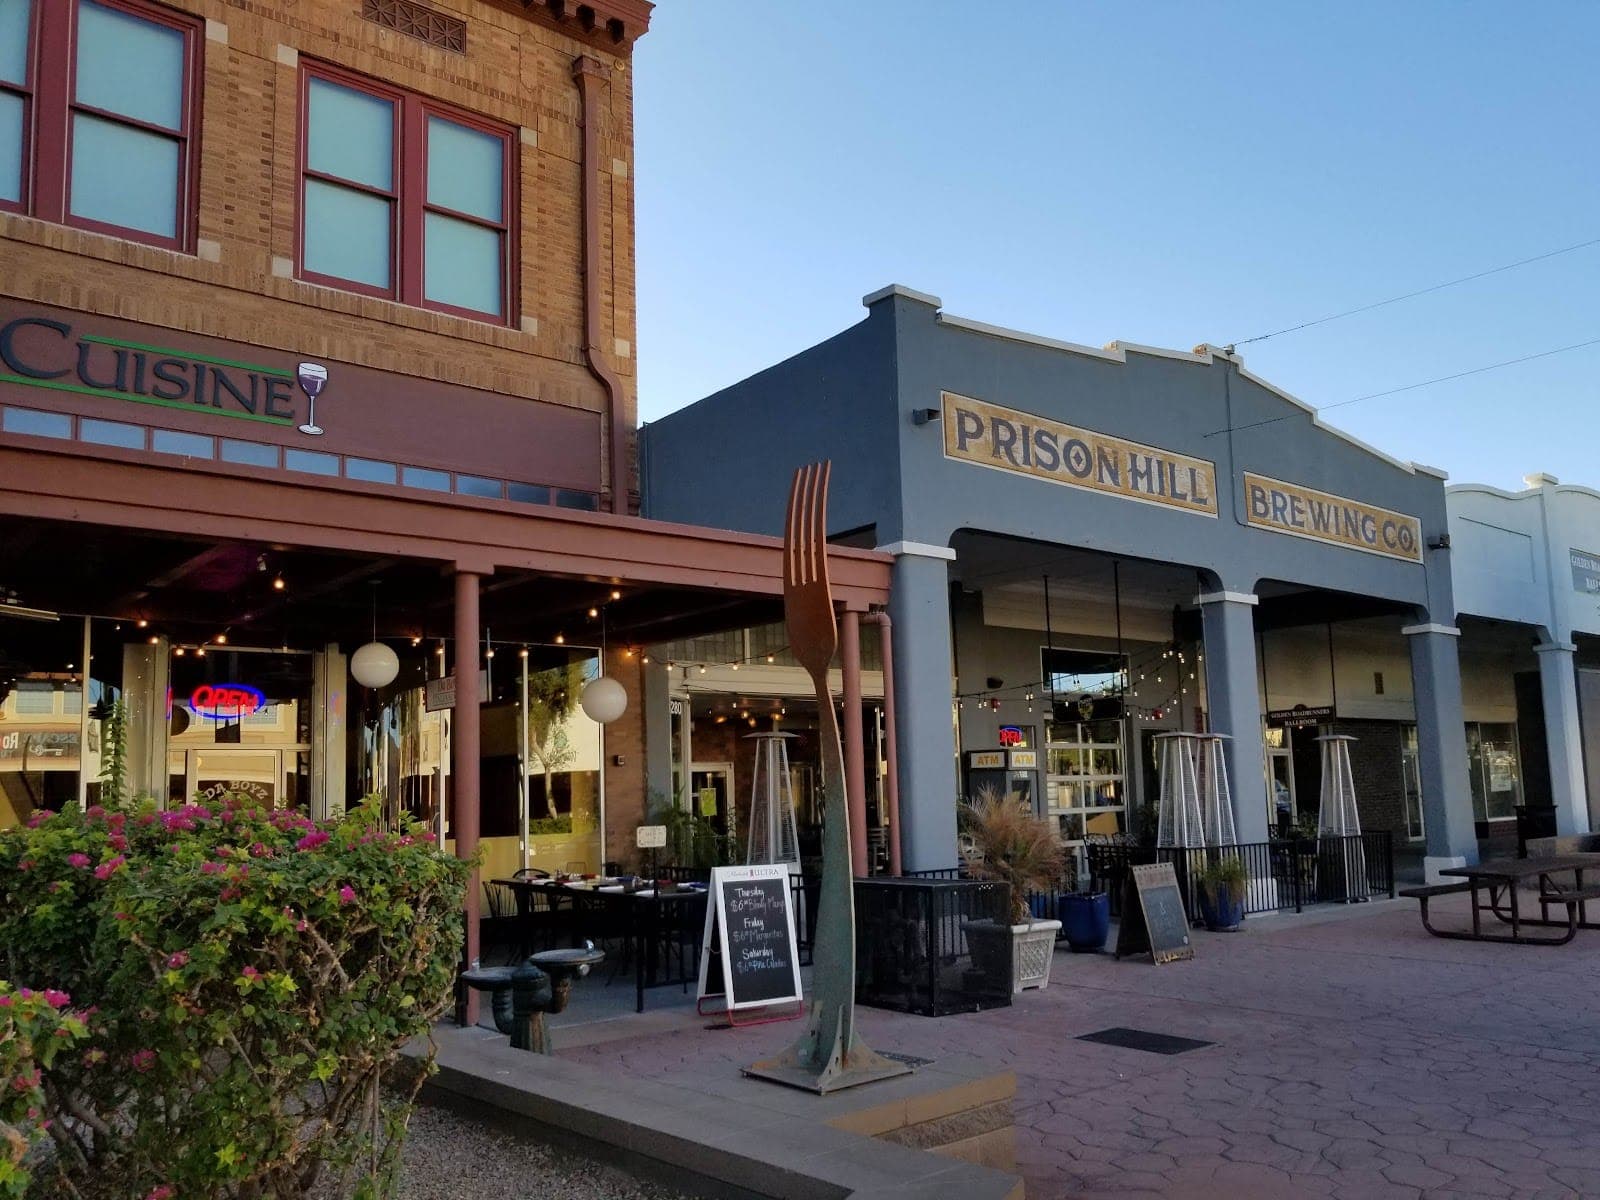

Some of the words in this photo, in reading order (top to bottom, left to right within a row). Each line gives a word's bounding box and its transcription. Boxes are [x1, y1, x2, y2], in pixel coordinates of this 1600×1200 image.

[0, 317, 296, 419] CUISINE
[956, 407, 1121, 488] PRISON
[1128, 452, 1208, 506] HILL
[1250, 484, 1377, 545] BREWING
[1382, 520, 1418, 555] CO.
[192, 685, 258, 715] OPEN
[976, 755, 999, 766] ATM
[1014, 755, 1034, 765] ATM
[204, 782, 226, 800] DA
[230, 780, 269, 800] BOYZ
[734, 886, 765, 900] Thursday
[743, 916, 765, 930] Friday
[742, 946, 775, 960] Saturday
